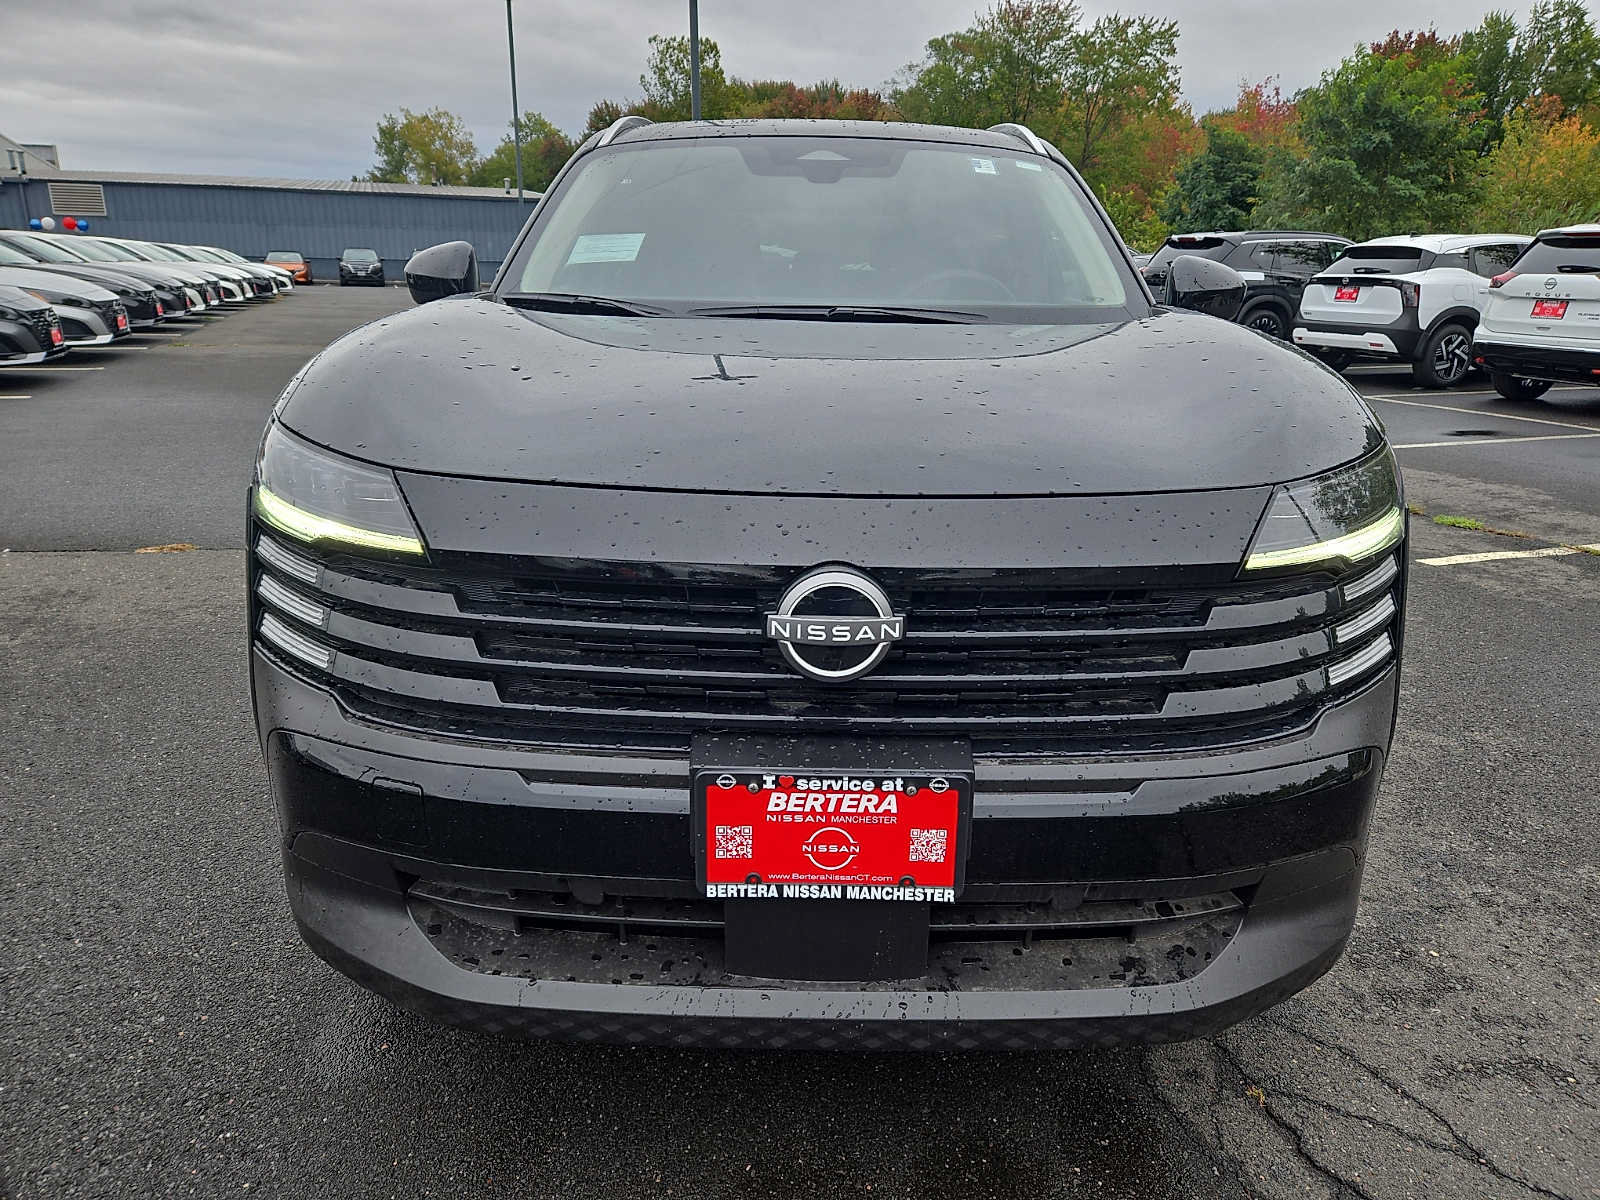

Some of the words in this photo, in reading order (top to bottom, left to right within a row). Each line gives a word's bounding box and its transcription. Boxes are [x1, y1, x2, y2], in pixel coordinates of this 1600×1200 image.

[770, 620, 900, 642] NISSAN
[762, 774, 776, 790] I
[796, 776, 876, 792] service
[881, 777, 904, 792] at
[766, 791, 898, 814] BERTERA
[766, 814, 826, 823] NISSAN
[831, 815, 897, 825] MANCHESTER
[802, 844, 860, 854] NISSAN
[767, 872, 893, 882] www.BerteraNissanCT.com
[706, 884, 779, 898] BERTERA
[783, 884, 841, 900] NISSAN
[846, 886, 955, 903] MANCHESTER
